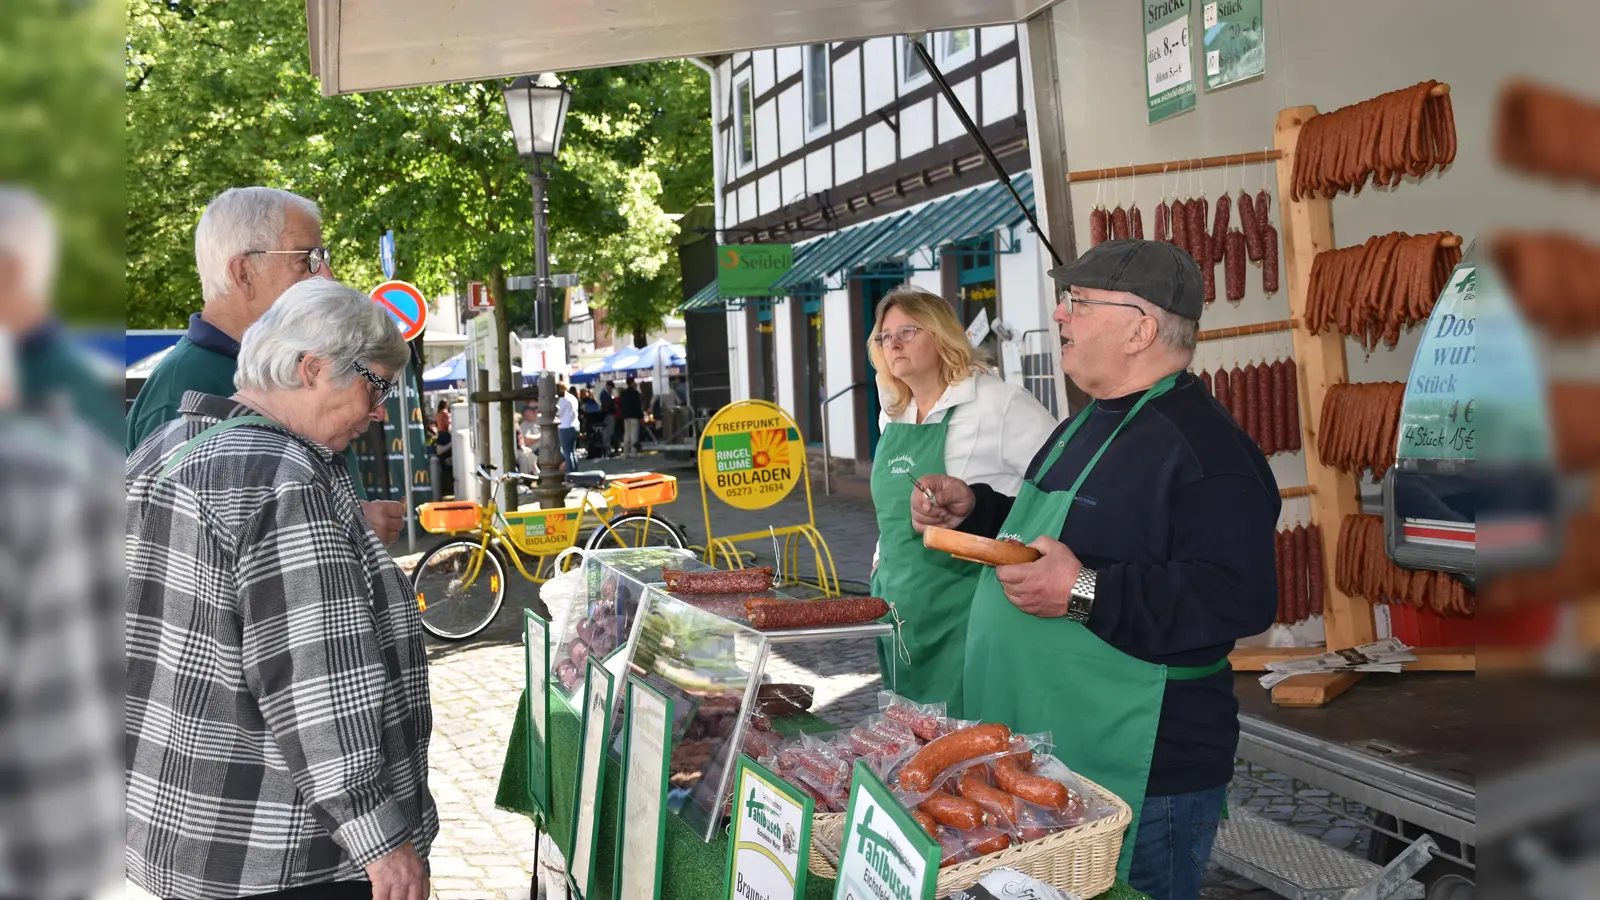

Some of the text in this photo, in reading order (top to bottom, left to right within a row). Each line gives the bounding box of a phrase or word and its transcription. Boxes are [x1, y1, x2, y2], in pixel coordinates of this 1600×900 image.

[1217, 0, 1243, 18] Stück
[1181, 27, 1188, 47] €
[1433, 345, 1475, 366] wur
[1414, 374, 1457, 395] Stück
[1448, 398, 1475, 424] 4 €
[716, 417, 780, 433] TREFFPUNKT
[1405, 427, 1415, 446] 4
[1414, 425, 1445, 448] Stück
[716, 447, 751, 461] RINGEL
[717, 458, 752, 472] BLUME
[717, 467, 791, 488] BIOLADEN
[726, 487, 752, 497] 05273
[760, 483, 784, 494] 21634
[525, 534, 568, 545] BIOLADEN
